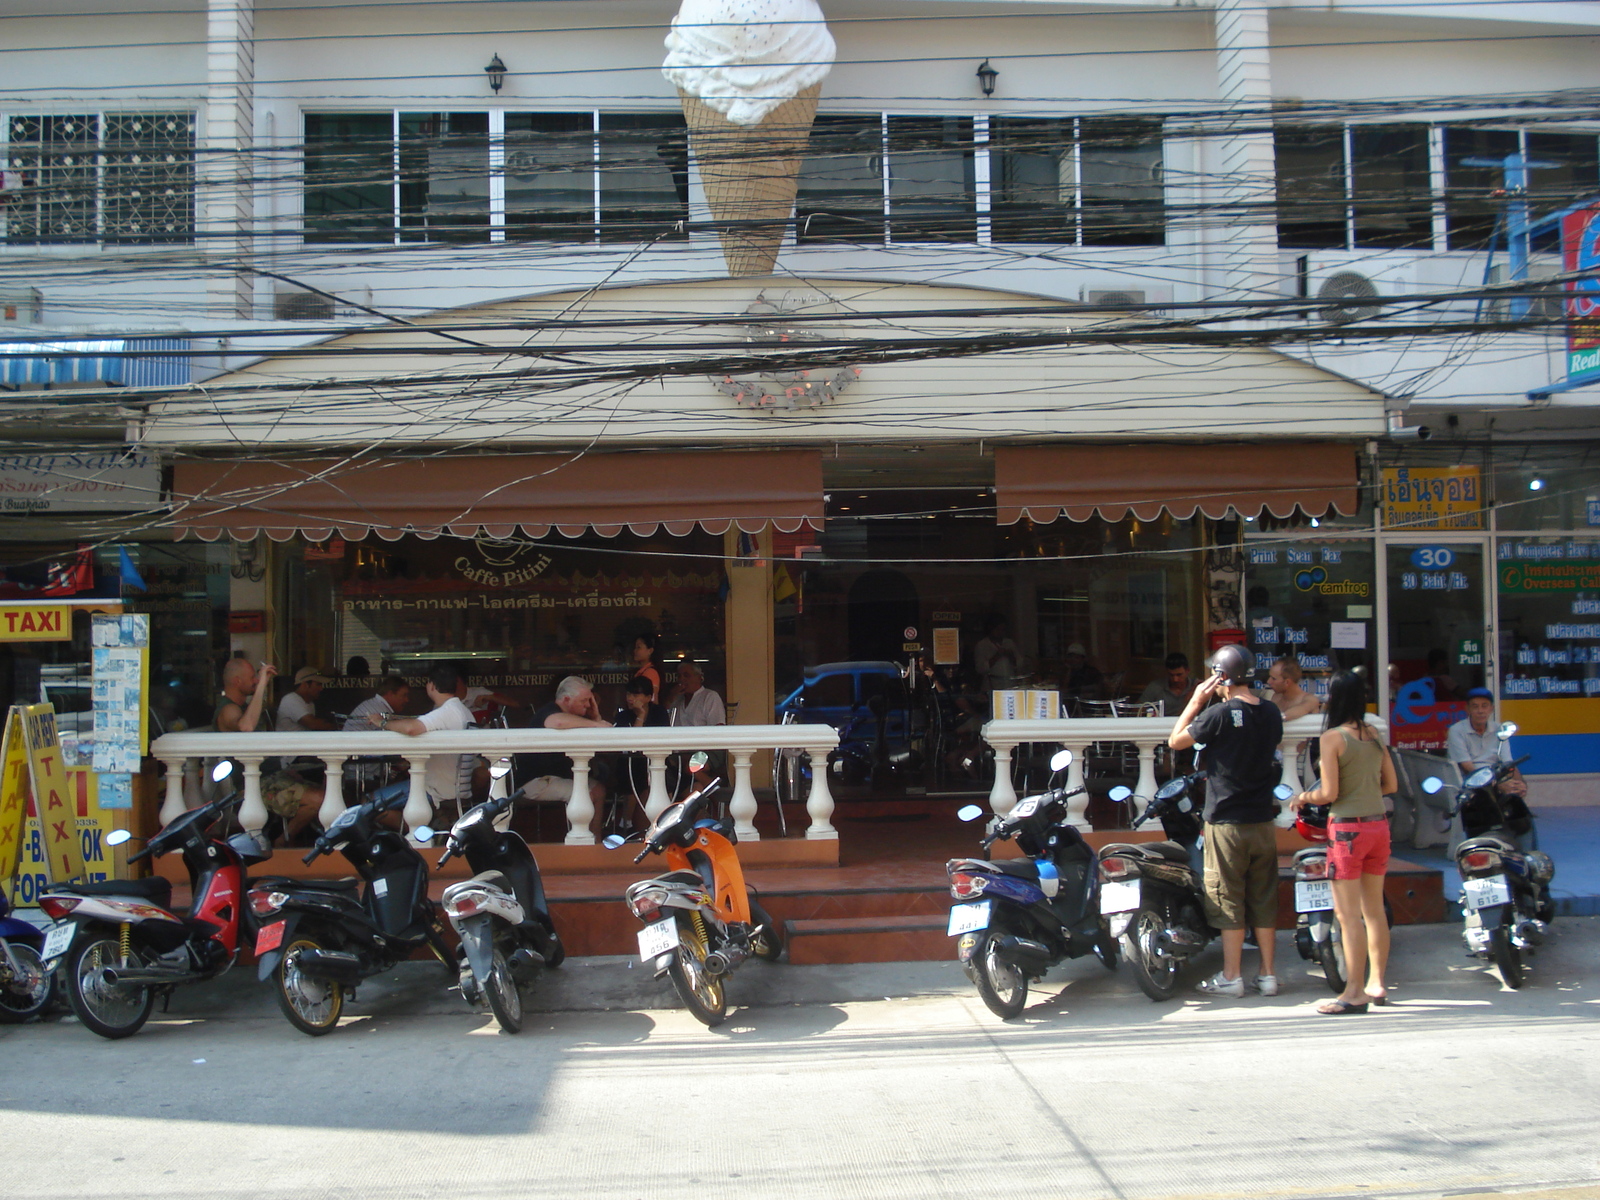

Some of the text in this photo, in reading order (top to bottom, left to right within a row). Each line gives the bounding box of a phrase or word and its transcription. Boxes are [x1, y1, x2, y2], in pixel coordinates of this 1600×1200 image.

[1250, 547, 1341, 564] Print Scan Fax
[1419, 548, 1452, 567] 30
[454, 553, 553, 587] Caffe Pitini
[1320, 580, 1369, 597] camfrog
[1402, 572, 1418, 590] 30
[1523, 578, 1577, 590] Overseas
[4, 611, 61, 633] TAXI
[1255, 626, 1308, 643] Real Fast
[1297, 652, 1329, 668] Zones
[1459, 654, 1481, 664] Pull
[468, 676, 499, 687] REAM
[40, 755, 71, 875] TAXI
[1309, 899, 1329, 909] 165
[1477, 894, 1499, 906] 612
